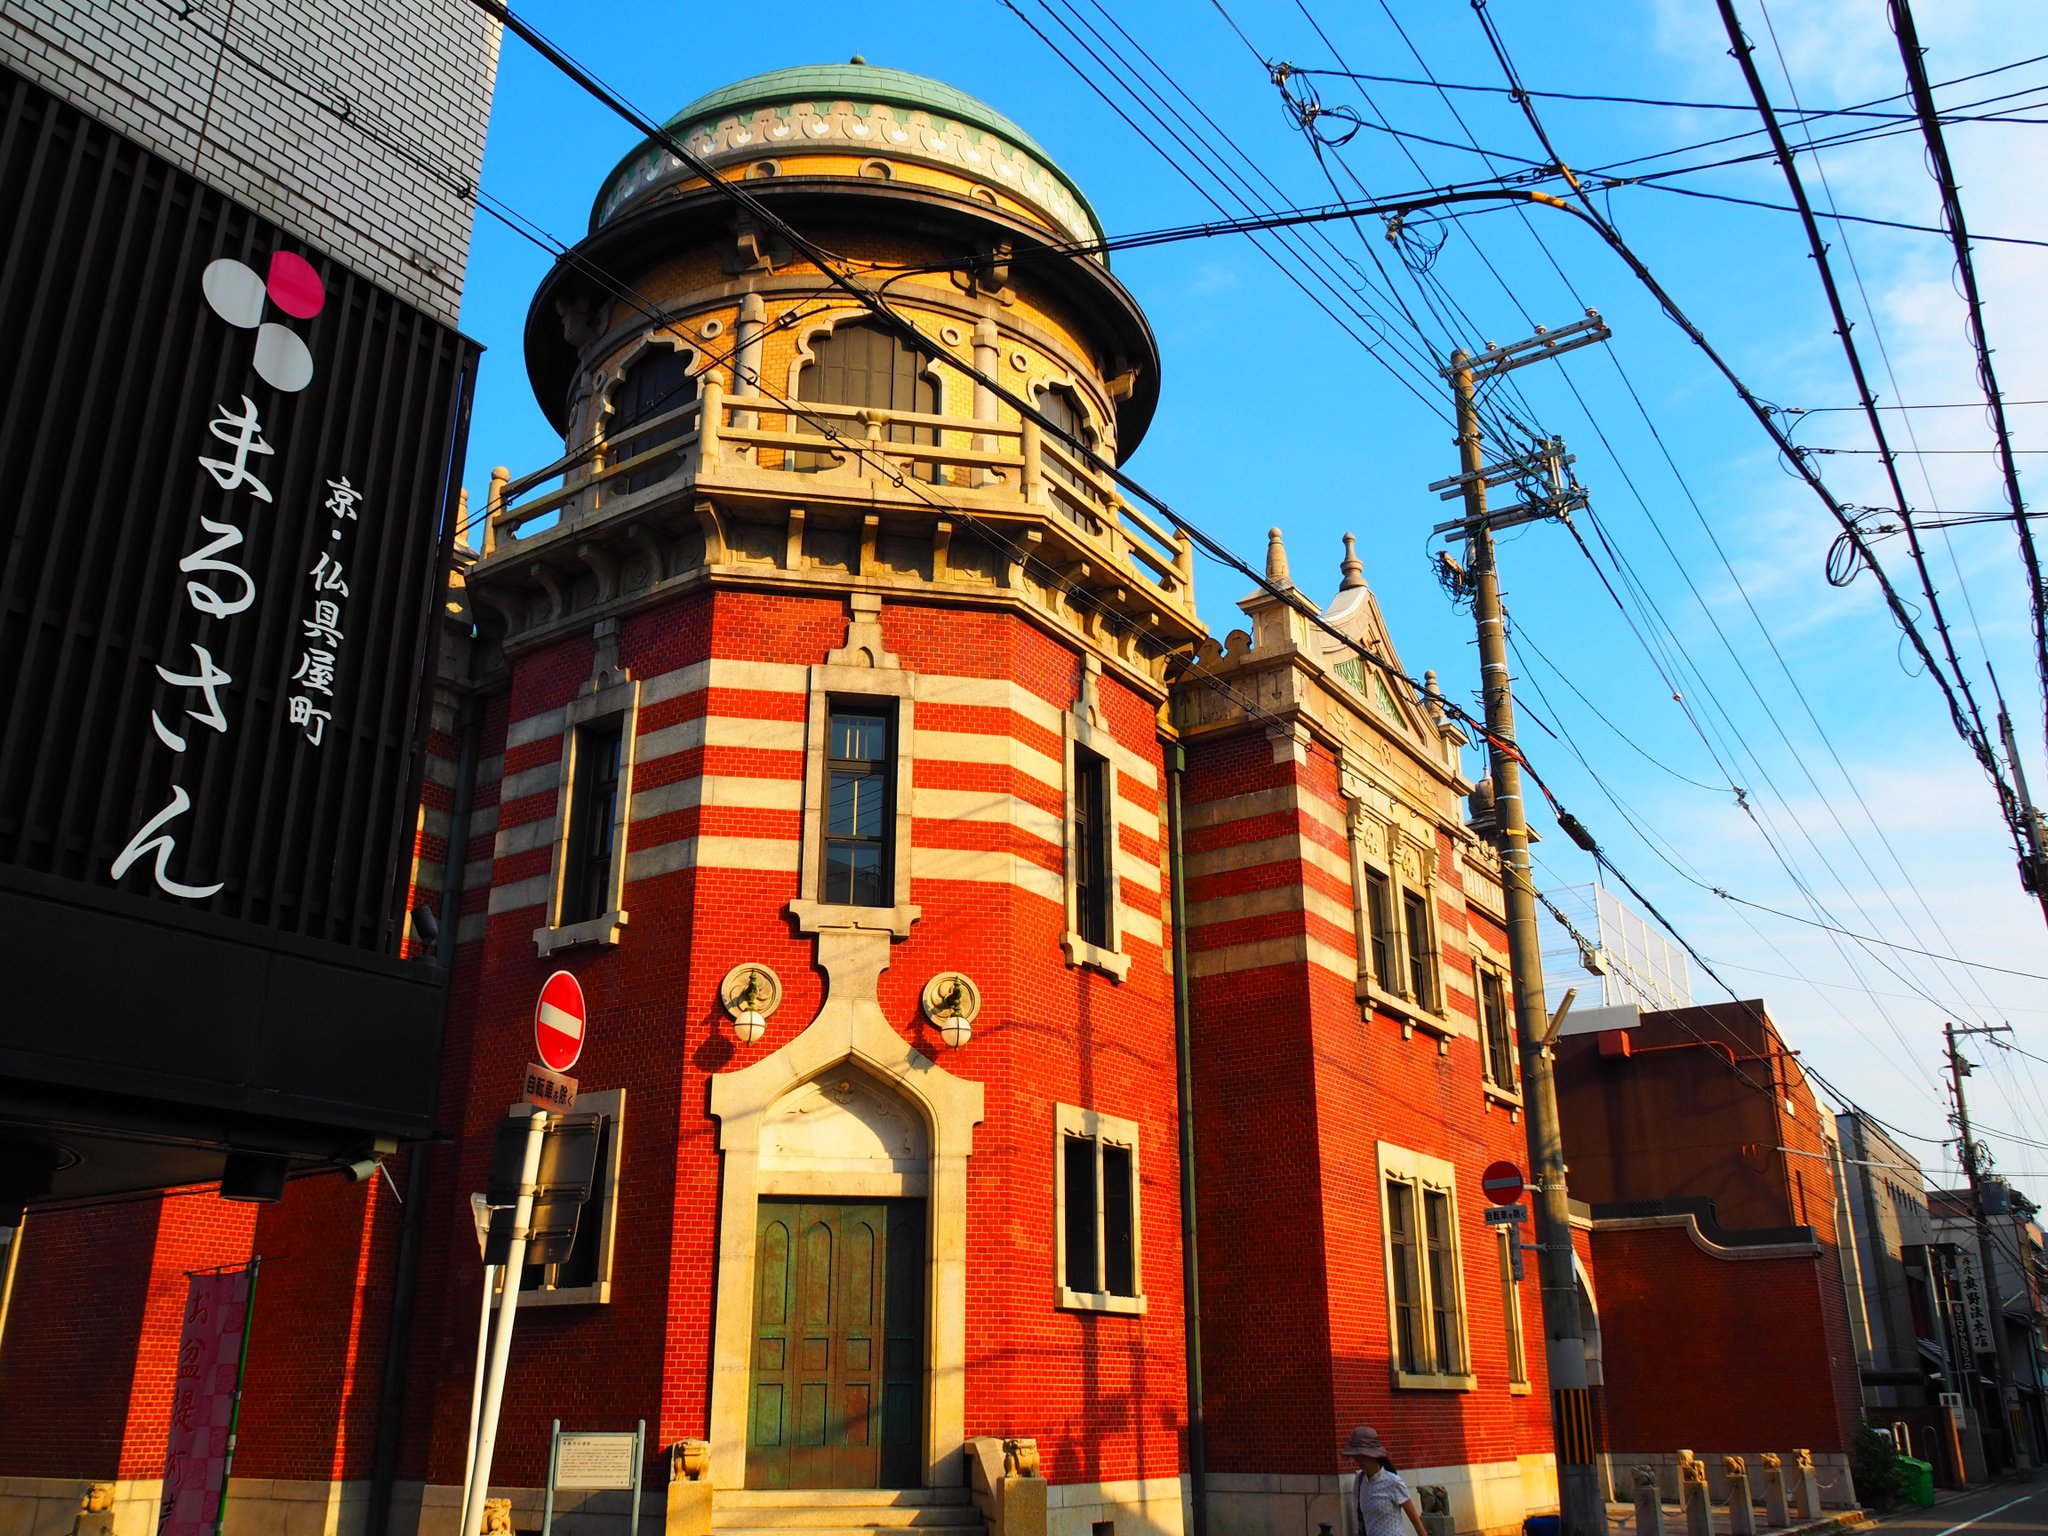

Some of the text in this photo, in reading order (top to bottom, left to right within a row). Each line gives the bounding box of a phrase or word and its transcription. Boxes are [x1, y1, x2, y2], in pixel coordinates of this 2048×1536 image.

[110, 395, 275, 899] まるさん
[527, 1074, 573, 1107] 自転車を除く
